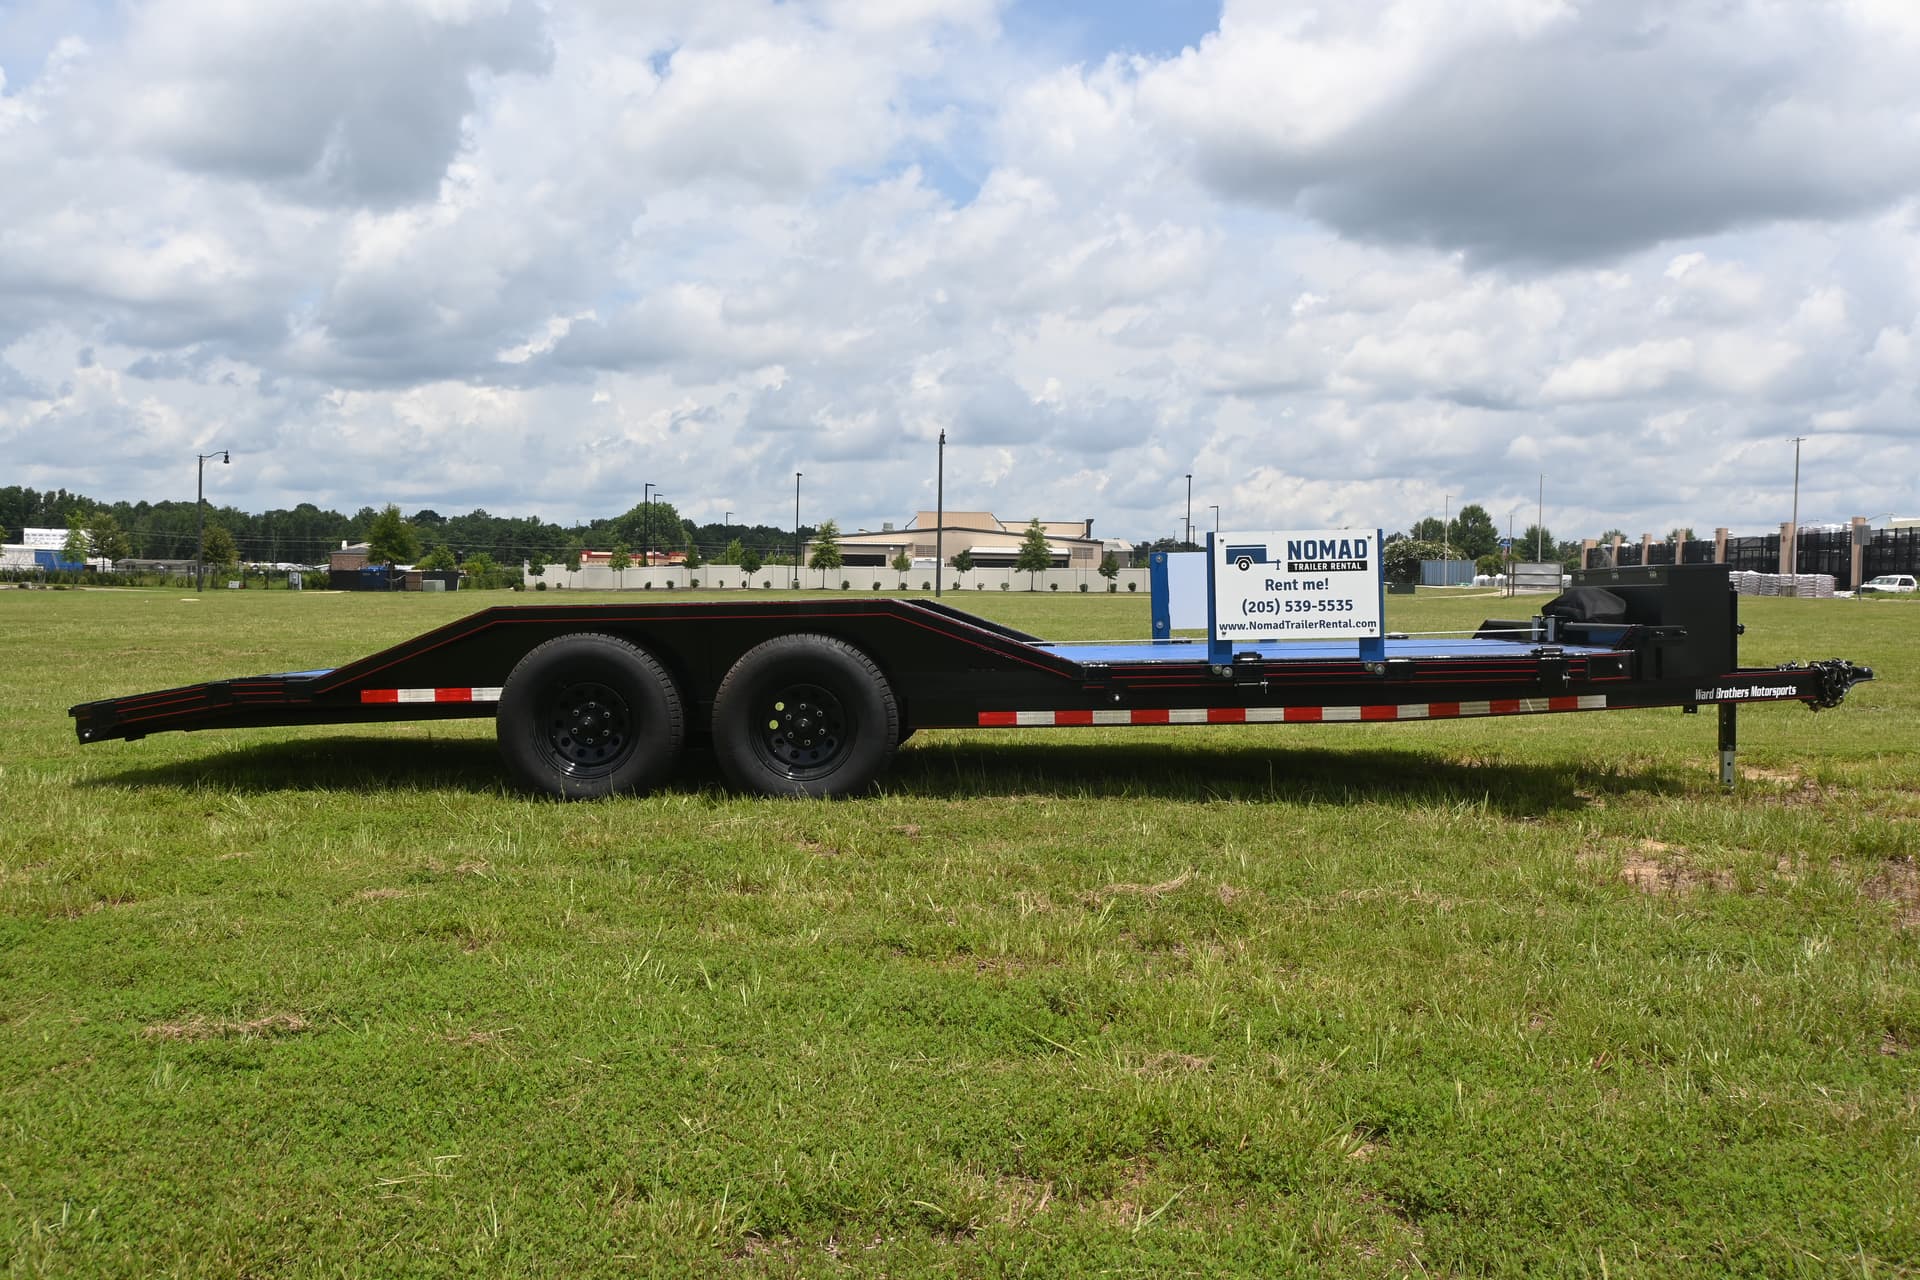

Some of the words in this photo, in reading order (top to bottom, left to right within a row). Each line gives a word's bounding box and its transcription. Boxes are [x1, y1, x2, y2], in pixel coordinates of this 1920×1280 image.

[1287, 539, 1368, 561] NOMAD
[1293, 563, 1328, 571] TRAILER
[1330, 562, 1362, 570] RENTAL
[1265, 579, 1299, 591] Rent
[1303, 578, 1329, 590] me!
[1242, 598, 1281, 616] (205)
[1285, 599, 1353, 612] 539-5535
[1219, 619, 1377, 631] www.NomadTrailerRental.com
[1695, 688, 1715, 700] Ward
[1716, 686, 1750, 699] Brothers
[1751, 685, 1797, 698] Motorsports
